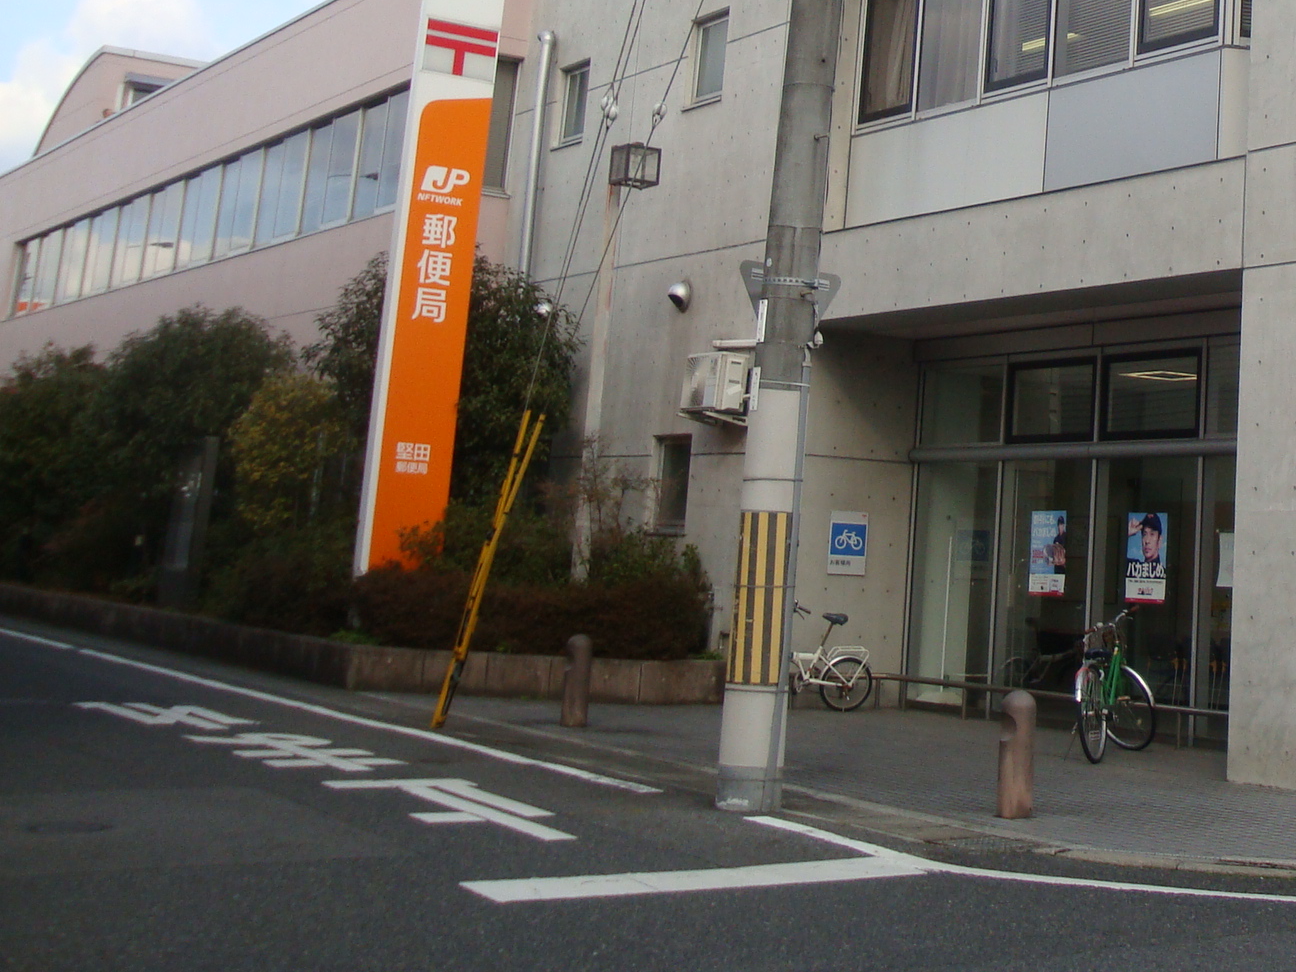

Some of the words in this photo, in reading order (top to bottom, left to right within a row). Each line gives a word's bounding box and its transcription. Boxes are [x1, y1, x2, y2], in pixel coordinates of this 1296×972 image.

[411, 213, 458, 323] 郵便局
[395, 441, 431, 462] 堅田
